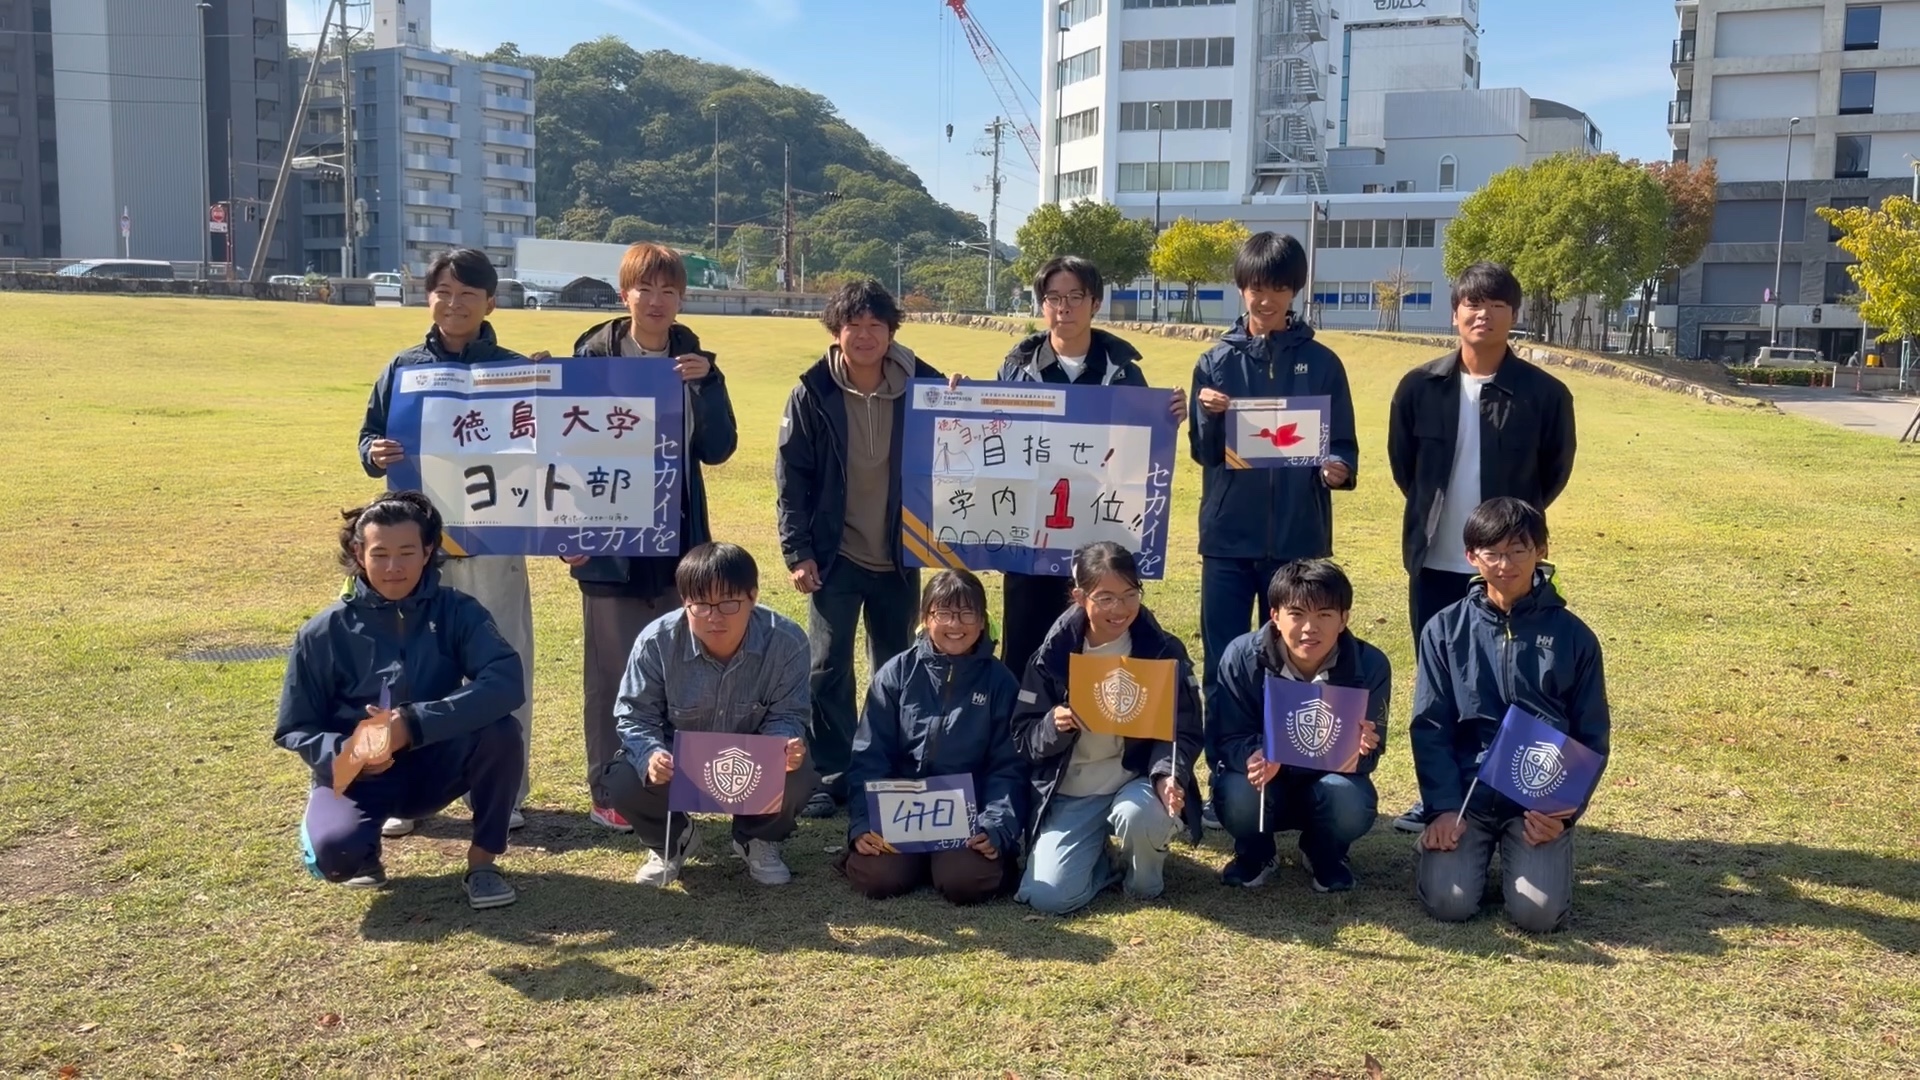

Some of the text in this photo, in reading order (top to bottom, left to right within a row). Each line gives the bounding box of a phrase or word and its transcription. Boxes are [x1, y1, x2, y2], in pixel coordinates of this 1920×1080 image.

[452, 400, 641, 447] 徳島大学
[463, 463, 632, 512] ヨット部
[1535, 634, 1555, 648] HH
[972, 692, 988, 706] HH
[892, 798, 955, 833] 470
